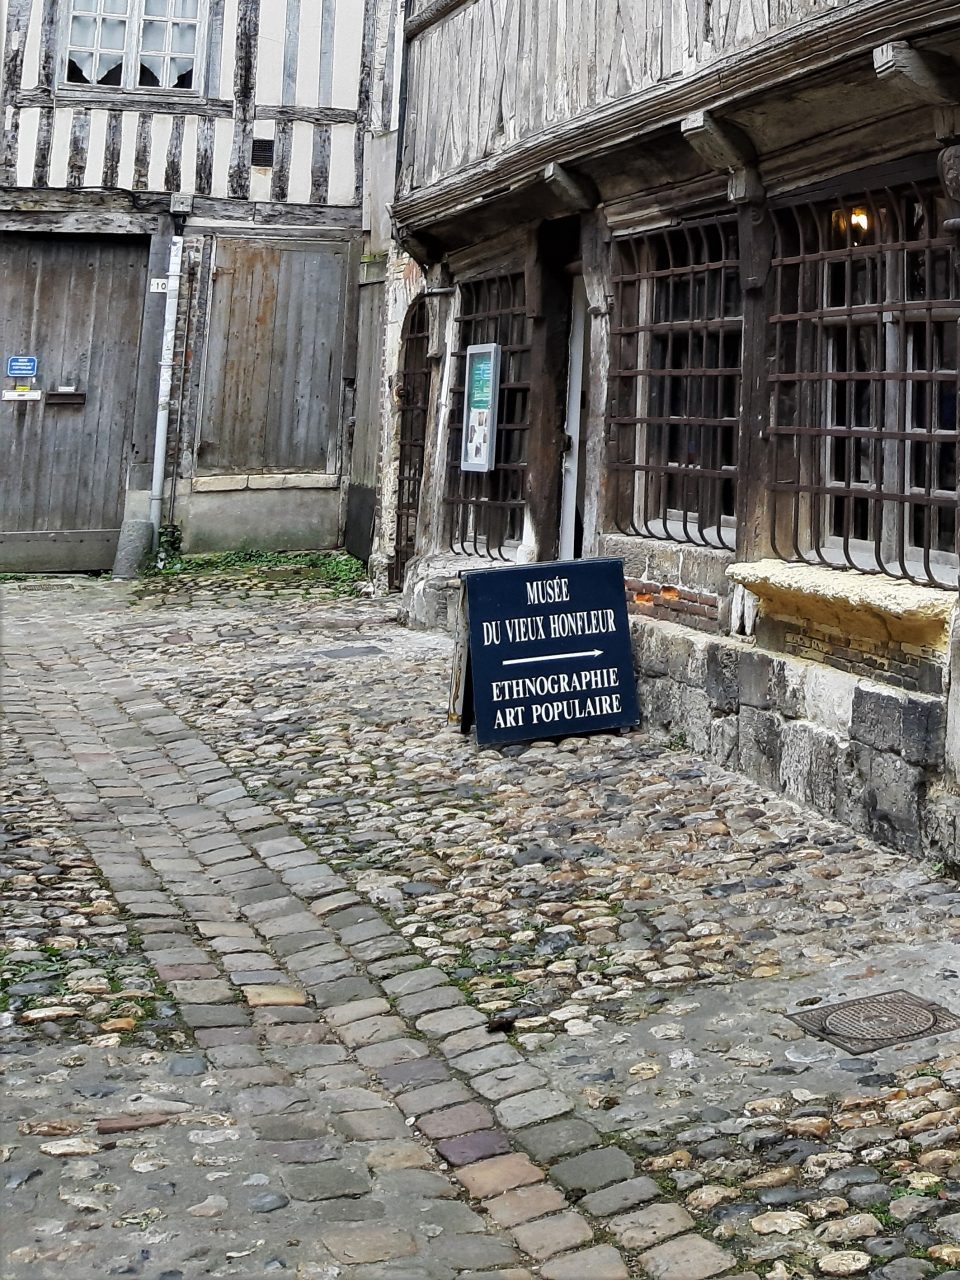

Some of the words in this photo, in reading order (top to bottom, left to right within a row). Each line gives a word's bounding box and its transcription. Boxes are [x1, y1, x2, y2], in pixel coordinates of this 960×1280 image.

[526, 576, 570, 605] MUSÉE
[482, 620, 501, 646] DU
[505, 616, 546, 643] VIEUX
[549, 609, 617, 639] HONFLEUR
[491, 667, 620, 702] ETHNOGRAPHIE
[493, 706, 525, 729] ART
[531, 693, 622, 725] POPULAIRE
